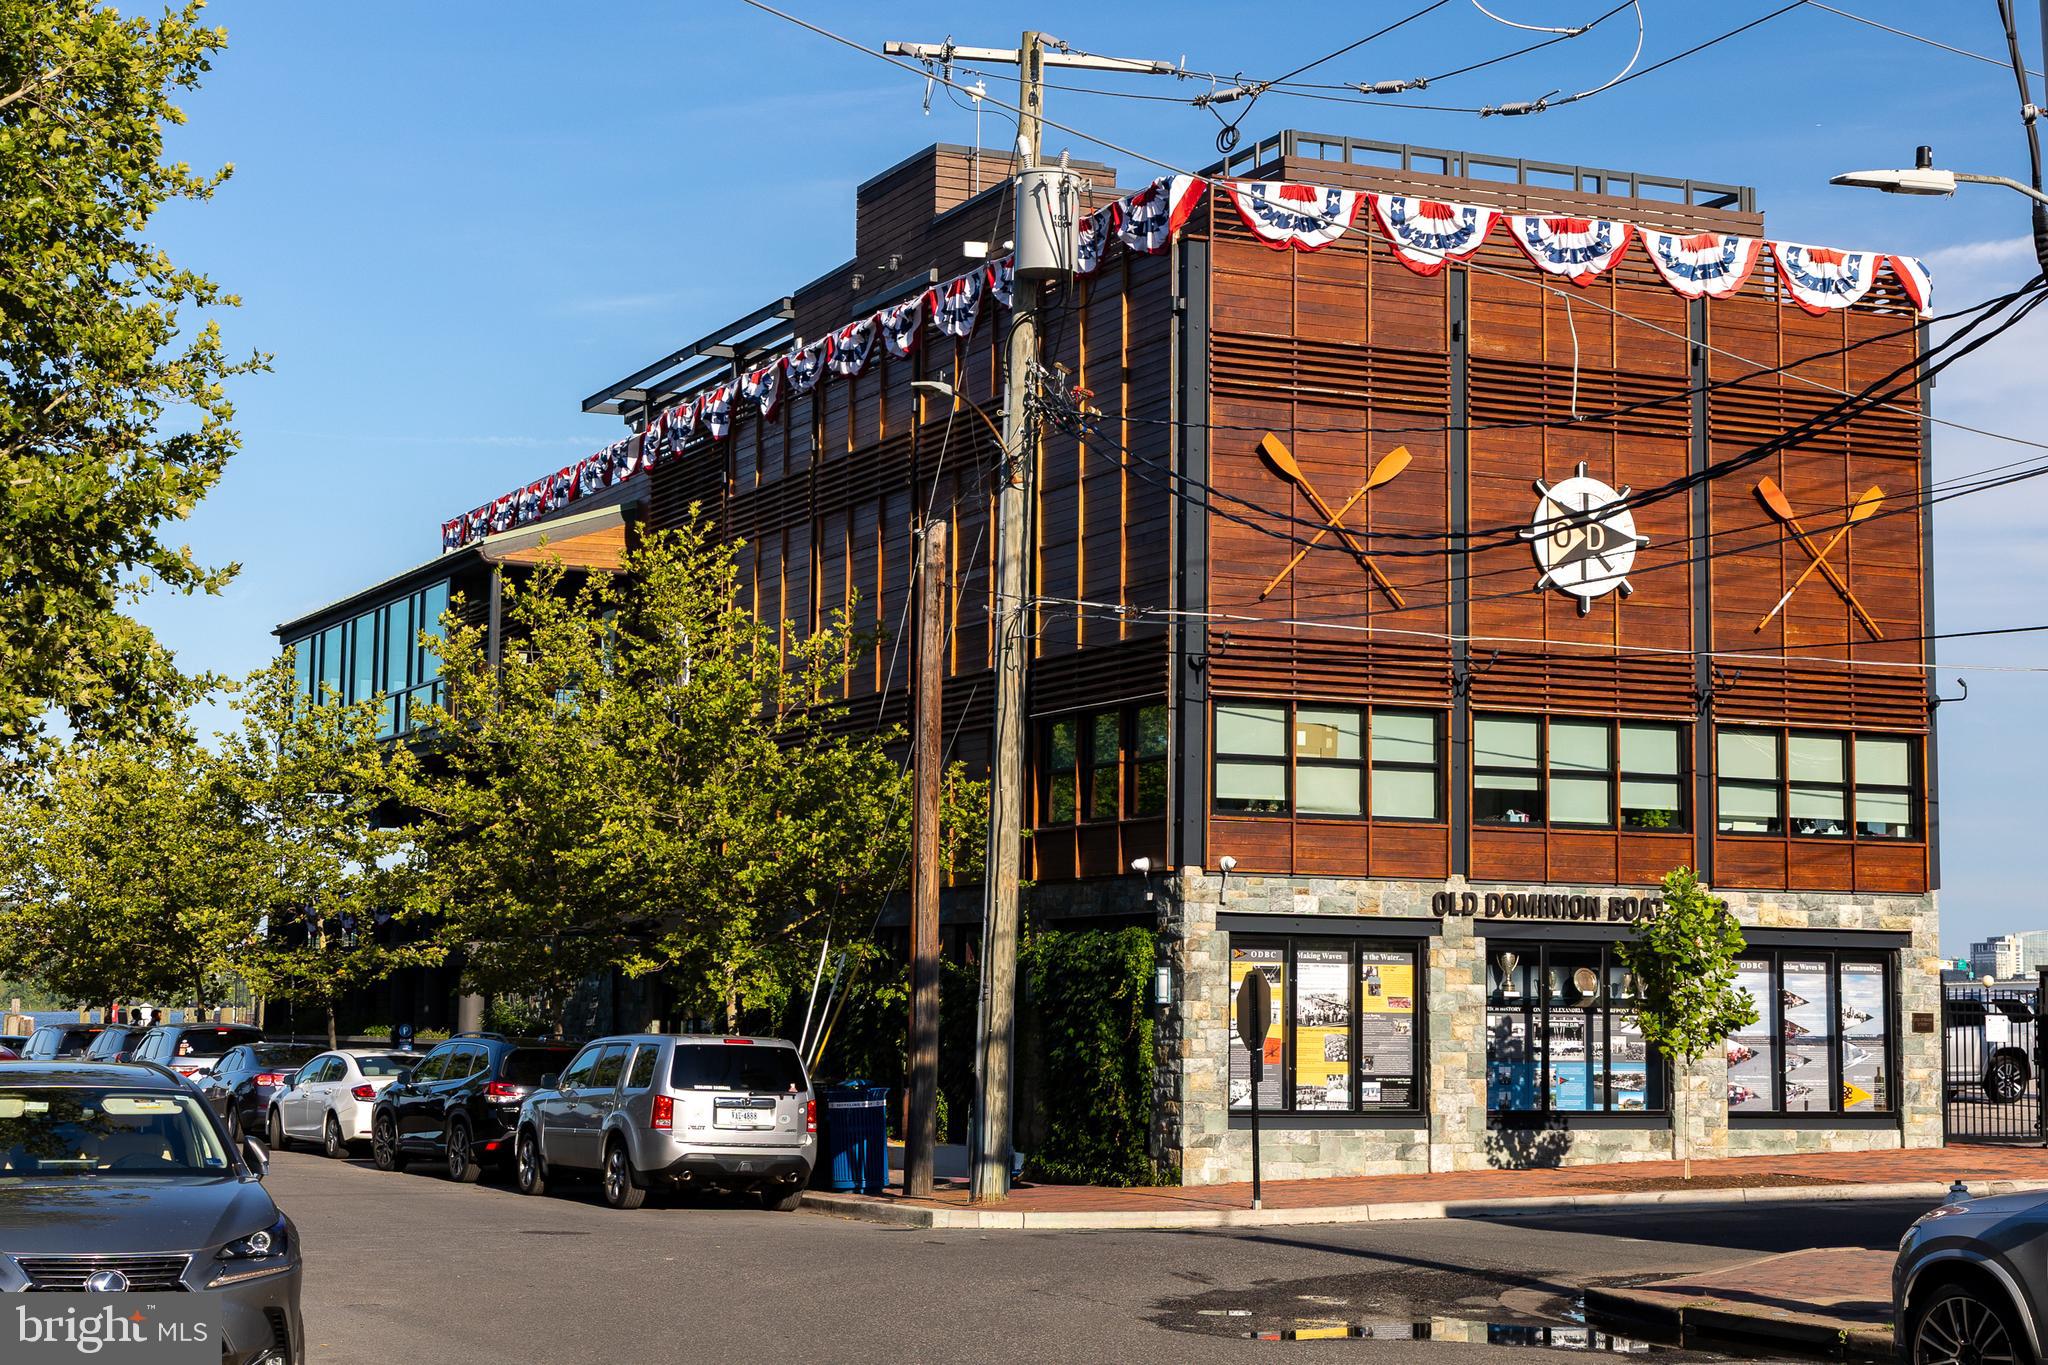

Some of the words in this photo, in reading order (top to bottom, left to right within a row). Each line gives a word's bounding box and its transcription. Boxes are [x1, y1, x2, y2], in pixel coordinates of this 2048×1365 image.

[1432, 891, 1478, 917] OLD
[1485, 893, 1600, 921] DOMINION
[1250, 950, 1277, 959] ODBC
[1322, 952, 1343, 960] Waves
[1369, 953, 1380, 961] the
[1740, 962, 1763, 970] ODBC
[1783, 963, 1799, 972] aking
